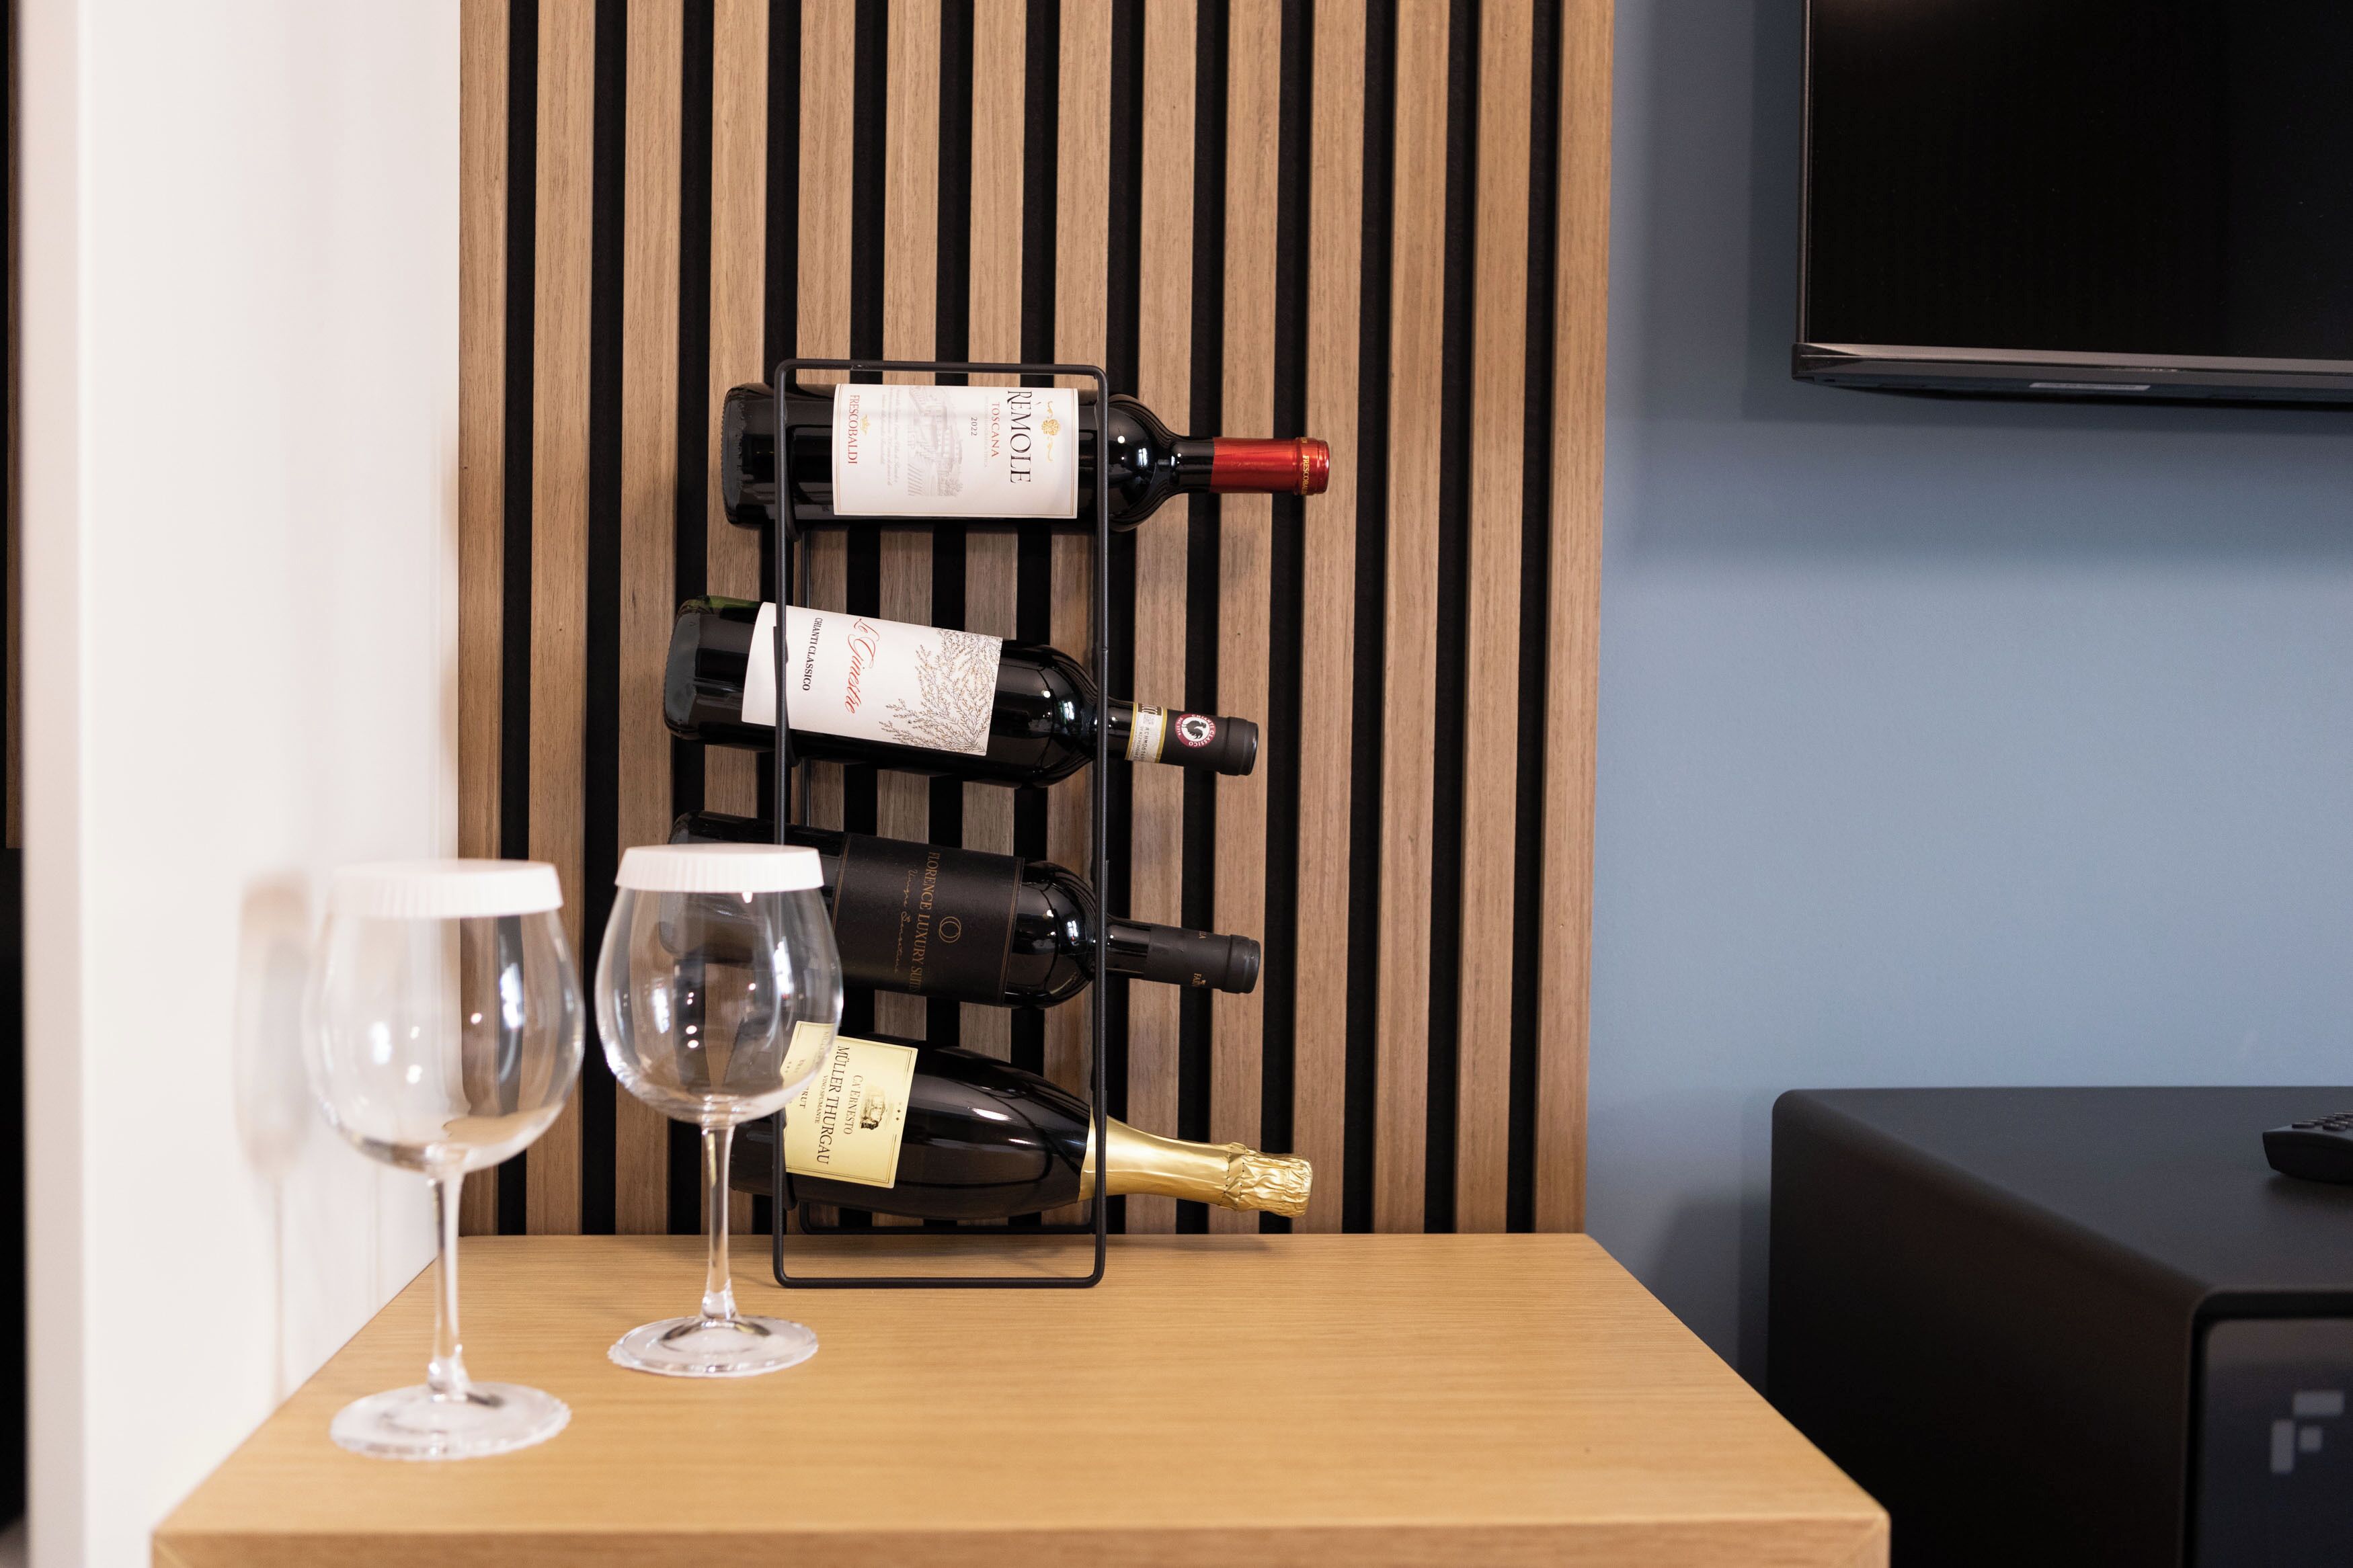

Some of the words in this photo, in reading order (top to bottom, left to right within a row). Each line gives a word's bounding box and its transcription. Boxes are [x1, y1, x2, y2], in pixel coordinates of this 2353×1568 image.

[848, 395, 860, 464] FRESCOBALDI
[991, 402, 1000, 457] TOSCANA
[1007, 390, 1041, 483] RÈMOLE
[810, 617, 823, 645] CHIANTI
[853, 618, 880, 641] Le
[802, 646, 817, 691] CLASSICO
[844, 634, 876, 714] Ginestre
[1189, 730, 1214, 747] CLASSICO
[919, 852, 941, 910] FLORENCE
[912, 913, 930, 965] LUXURY
[828, 1046, 850, 1092] MÜLLER
[814, 1090, 825, 1124] SPUMANTE
[816, 1096, 840, 1165] THURGAU
[843, 1089, 861, 1134] ERNESTO
